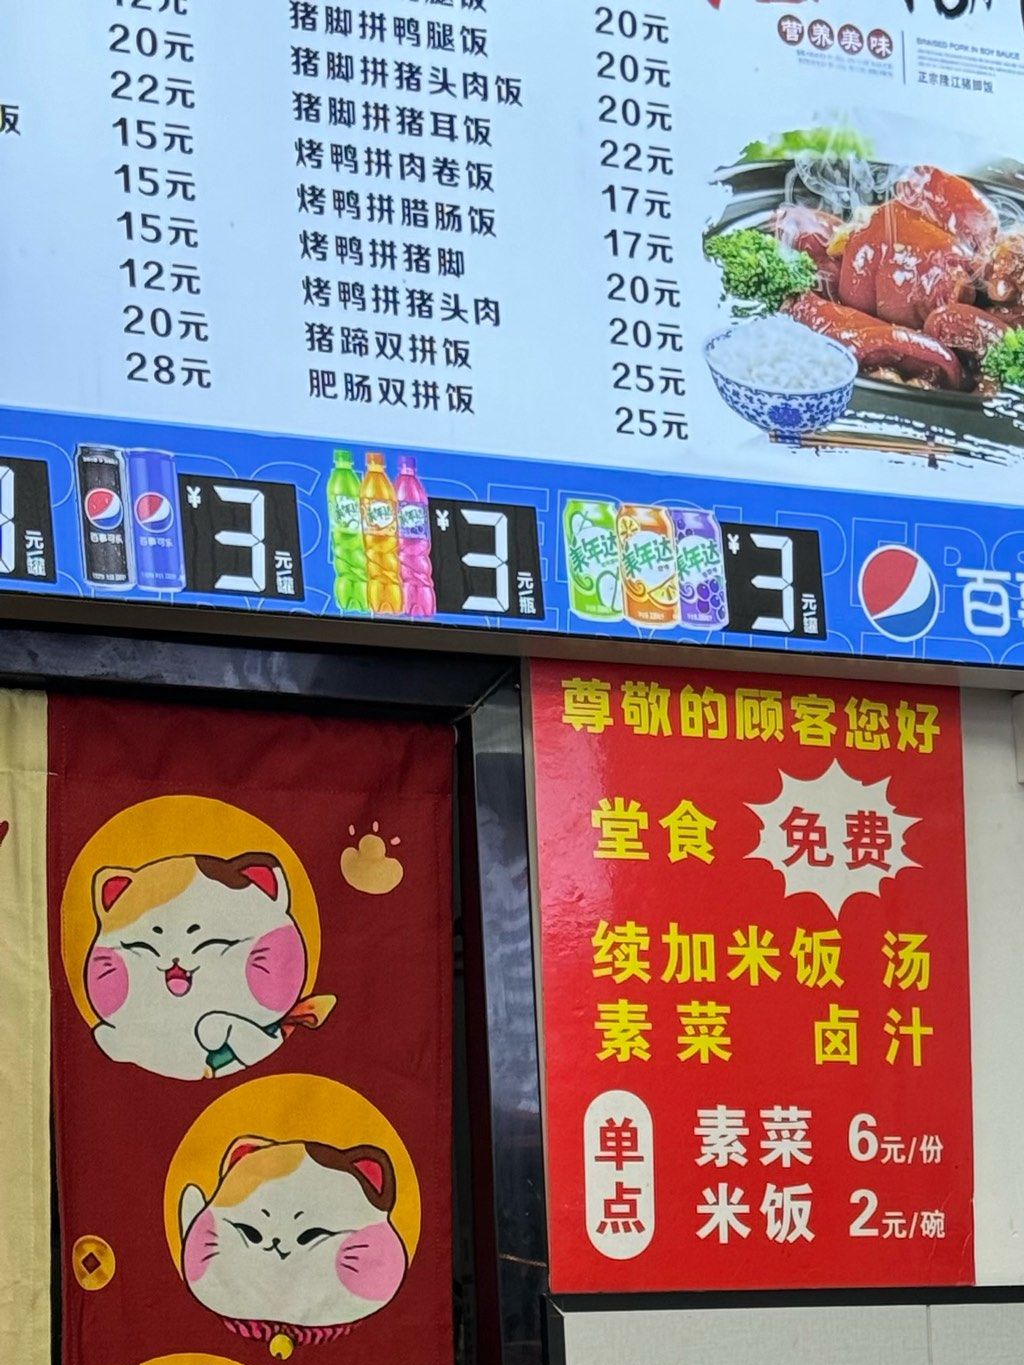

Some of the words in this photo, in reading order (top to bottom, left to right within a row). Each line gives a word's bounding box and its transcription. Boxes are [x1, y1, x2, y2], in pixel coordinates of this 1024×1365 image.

[108, 23, 195, 62] 20元
[289, 0, 489, 58] 猪脚拼鸭腿饭
[596, 51, 671, 89] 20元
[595, 7, 669, 44] 20元
[781, 16, 893, 58] 营养美味
[110, 70, 196, 109] 22元
[291, 45, 523, 108] 猪脚拼猪头肉饭
[598, 95, 673, 132] 20元
[112, 117, 194, 155] 15元
[292, 90, 493, 148] 猪脚拼猪耳饭
[600, 139, 673, 176] 22元
[114, 164, 197, 201] 15元
[295, 137, 495, 193] 烤鸭拼肉卷饭
[601, 184, 672, 220] 17元
[116, 211, 199, 249] 15元
[296, 184, 498, 238] 烤鸭拼腊肠饭
[603, 229, 674, 264] 17元
[119, 258, 202, 296] 12元
[299, 230, 466, 279] 烤鸭拼猪脚
[606, 273, 682, 309] 20元
[123, 306, 210, 343] 20元
[301, 276, 502, 328] 烤鸭拼猪头肉
[608, 318, 685, 353] 20元
[126, 352, 212, 390] 28元
[305, 322, 472, 370] 猪蹄双拼饭
[611, 362, 687, 398] 25元
[308, 368, 476, 414] 肥肠双拼饭
[614, 406, 689, 442] 25元
[561, 677, 941, 754] 尊敬的顾客您好
[590, 797, 717, 864] 堂食
[779, 807, 893, 872] 免费
[591, 921, 845, 989] 续加米饭
[881, 930, 931, 991] 汤
[593, 998, 733, 1064] 素菜
[814, 1004, 934, 1066] 卤汁
[693, 1104, 814, 1168] 素菜
[847, 1113, 944, 1166] 6元/份
[594, 1116, 647, 1235] 单点
[695, 1182, 816, 1245] 米饭
[848, 1188, 946, 1240] 2元/碗
